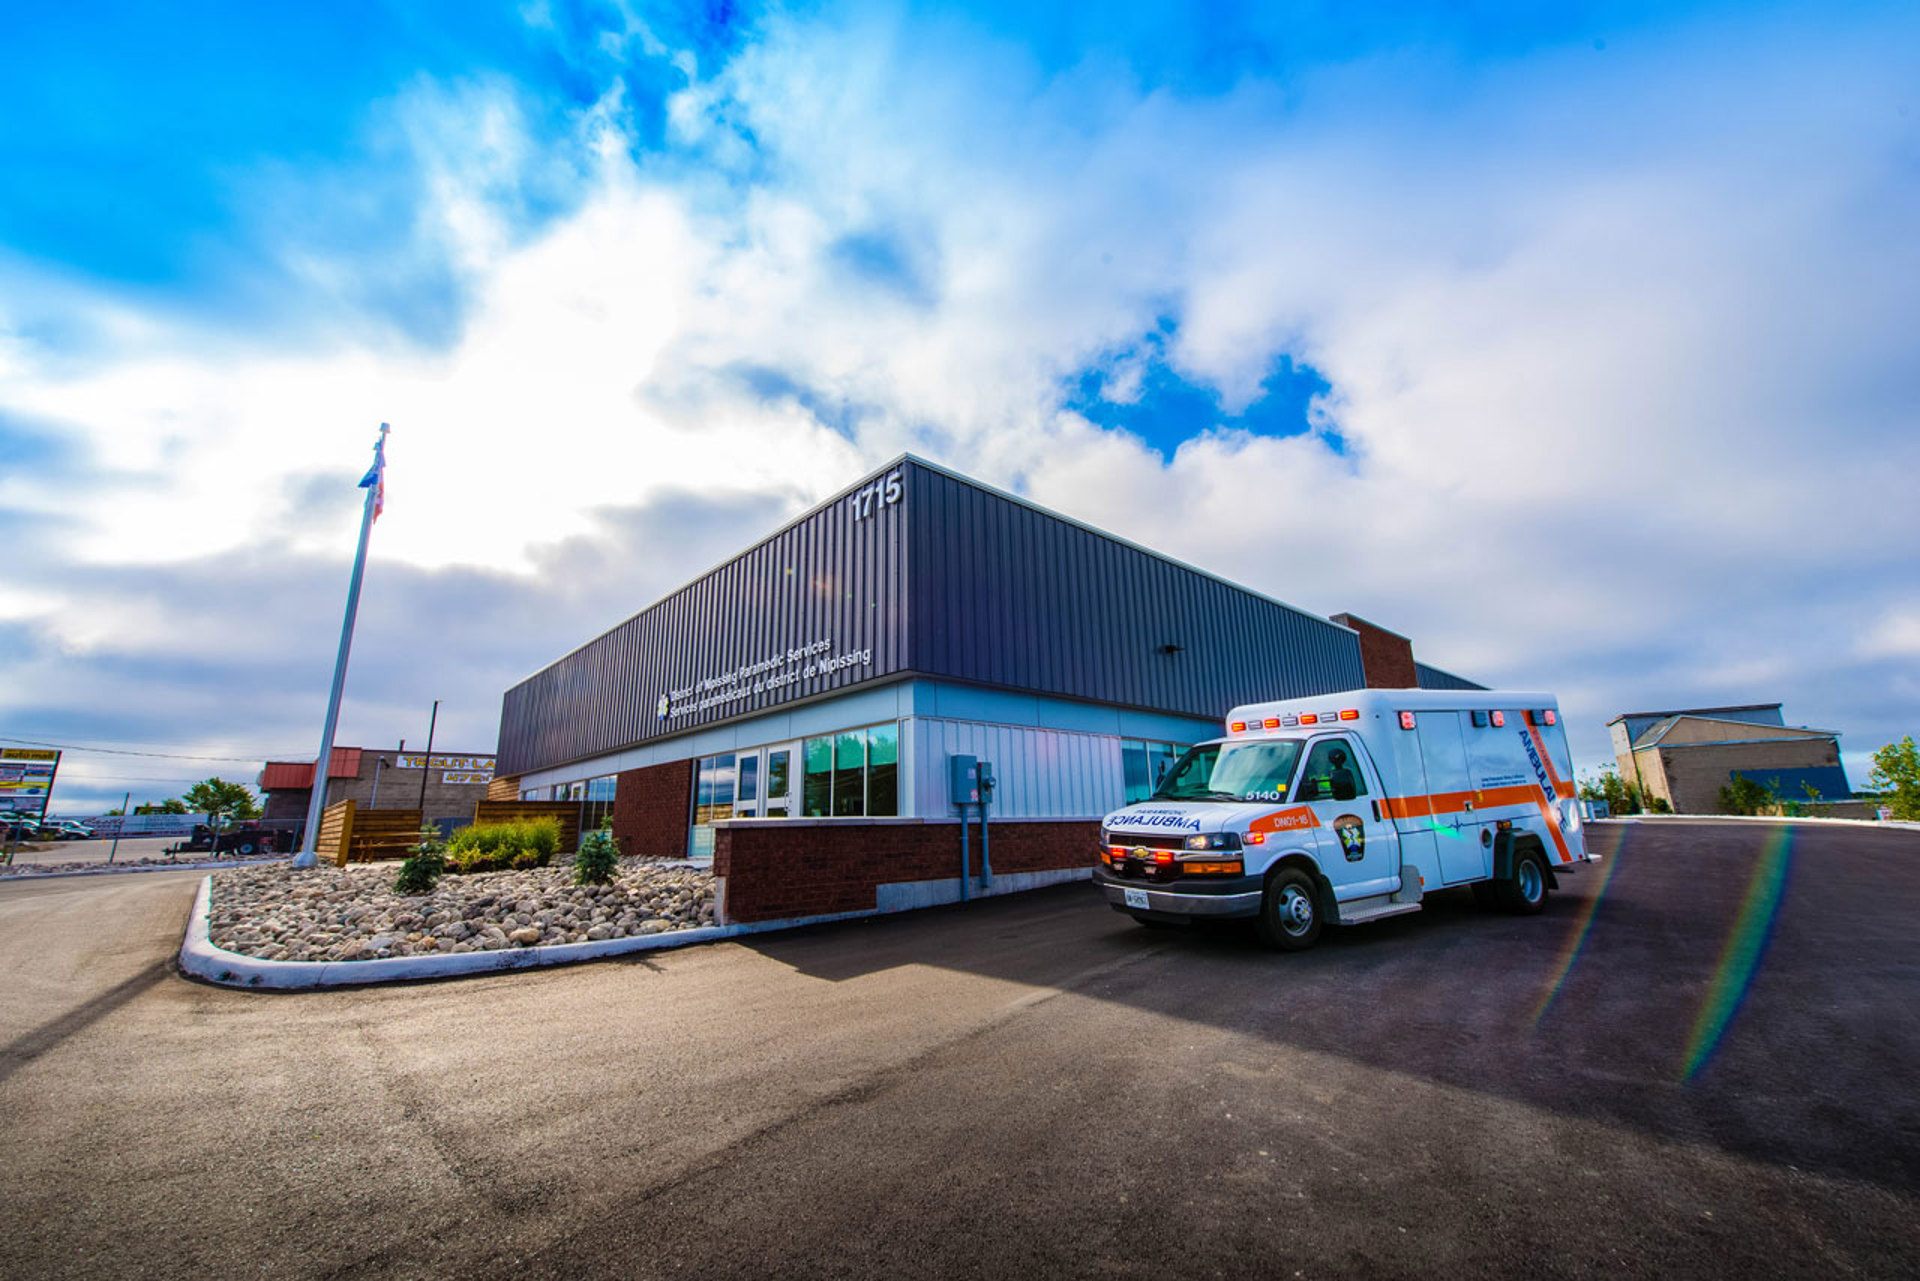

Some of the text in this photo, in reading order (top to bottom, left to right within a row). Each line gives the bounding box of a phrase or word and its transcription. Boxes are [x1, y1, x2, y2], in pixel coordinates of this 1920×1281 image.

[853, 472, 901, 521] 1715
[670, 702, 698, 718] Services
[753, 680, 764, 694] du
[767, 668, 799, 689] district
[803, 664, 816, 679] de
[819, 648, 871, 674] Nipissing
[704, 672, 738, 692] Nipissing
[739, 654, 784, 681] Paramedic
[787, 639, 830, 663] Services
[403, 757, 468, 769] TROUT
[1246, 791, 1280, 801] 5140
